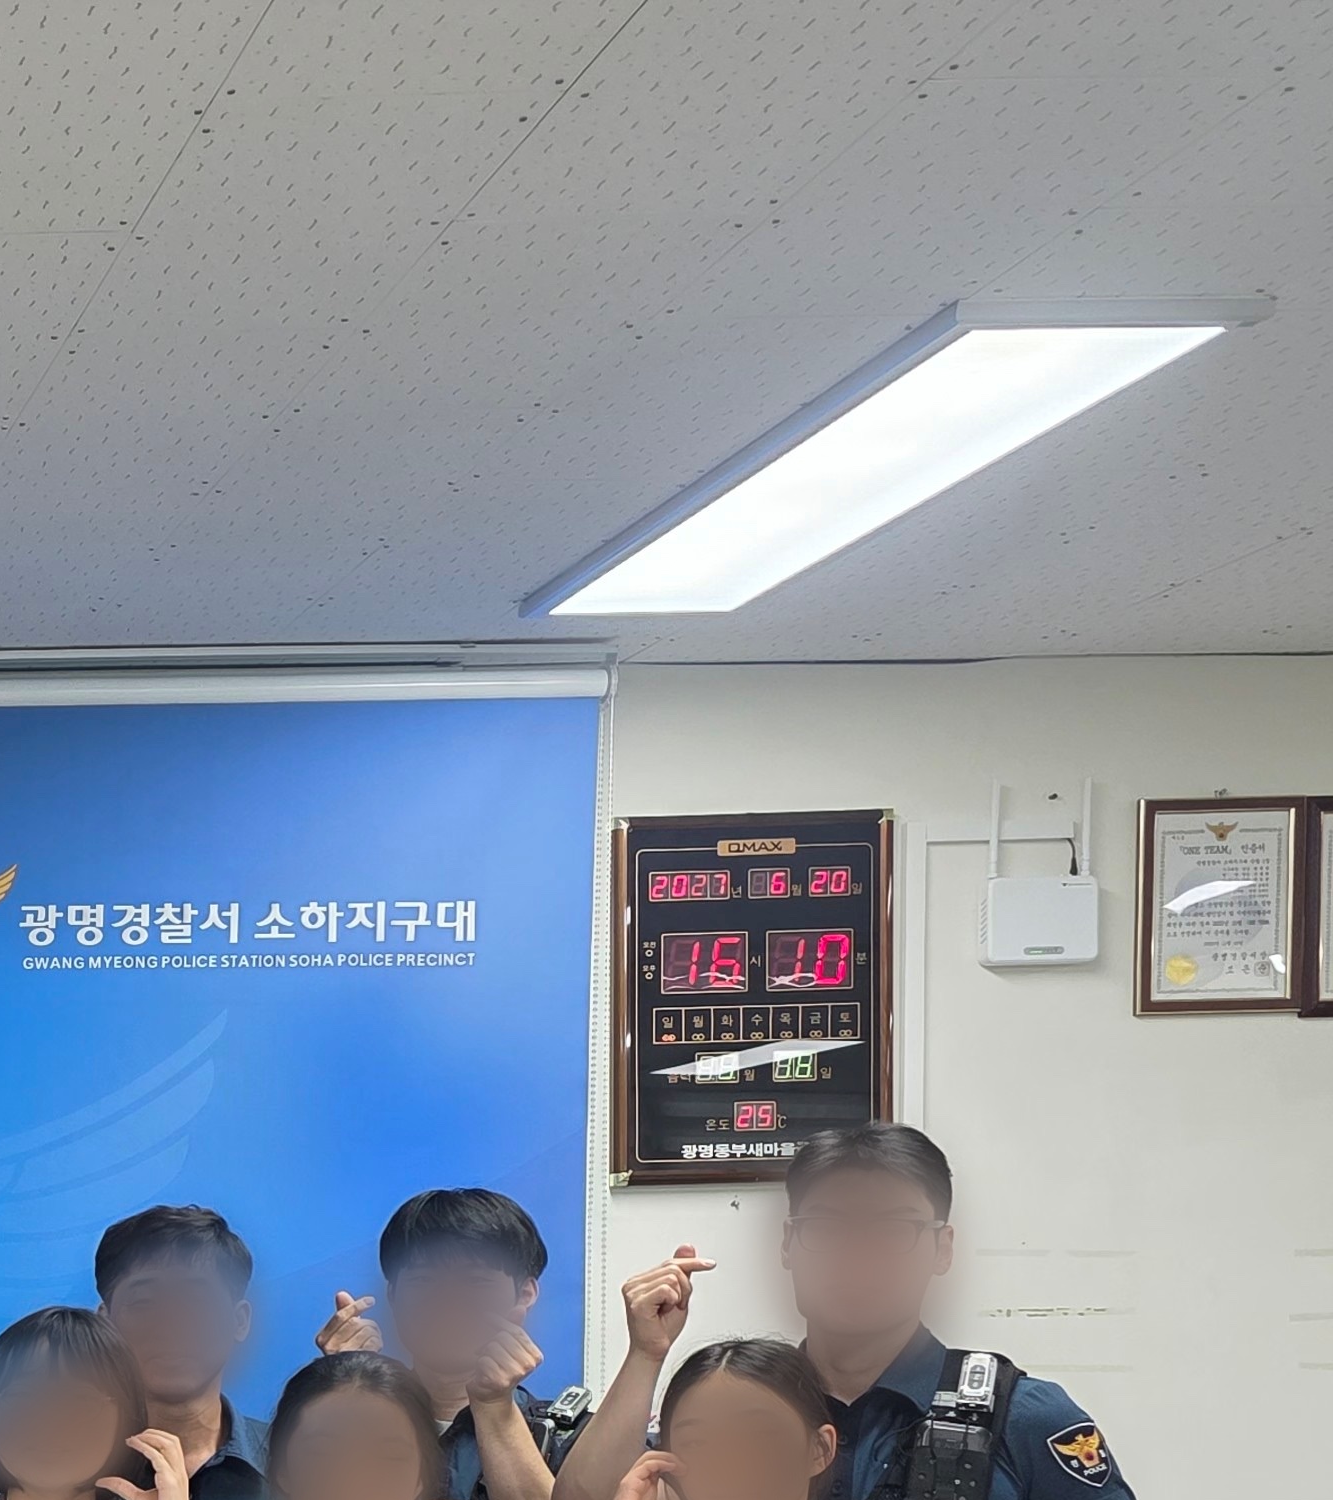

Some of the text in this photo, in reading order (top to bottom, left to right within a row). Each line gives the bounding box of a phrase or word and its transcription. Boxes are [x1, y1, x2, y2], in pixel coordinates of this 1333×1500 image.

[728, 842, 782, 853] QMAX
[652, 874, 726, 898] 2027
[811, 871, 847, 893] 20
[19, 900, 476, 946] 광명경찰서 소하지구대
[23, 952, 476, 970] GWANG MYEONG POLICE STATION SOHA POLICE PRECINCT
[750, 955, 761, 967] 시
[794, 934, 850, 985] 10
[661, 1015, 674, 1029] 일
[721, 1013, 733, 1027] 화
[751, 1013, 763, 1026] 수
[810, 1012, 822, 1024] 금
[705, 1119, 730, 1131] 온도
[737, 1105, 773, 1128] 25
[681, 1142, 799, 1159] 광명동부새마을
